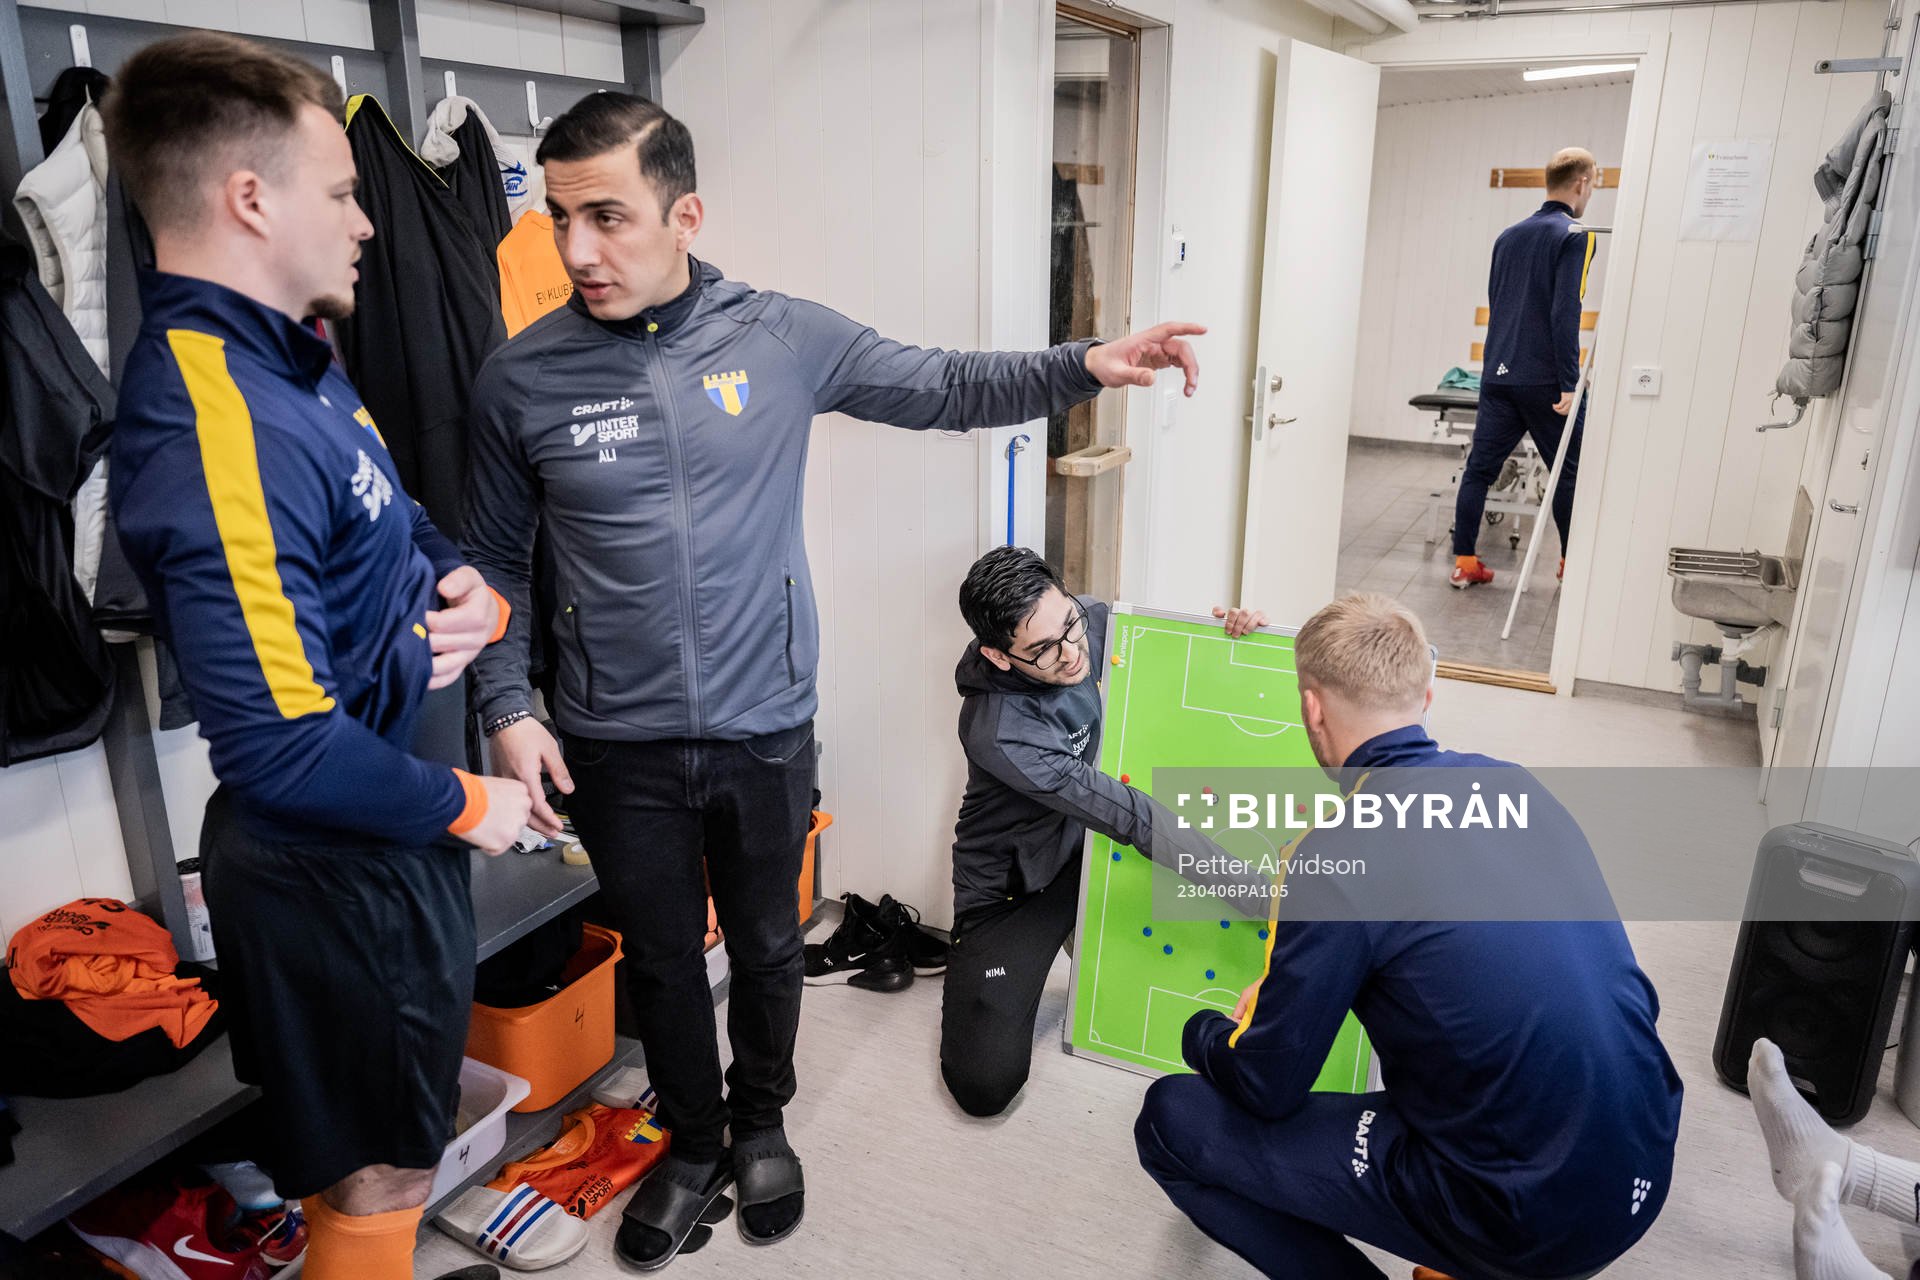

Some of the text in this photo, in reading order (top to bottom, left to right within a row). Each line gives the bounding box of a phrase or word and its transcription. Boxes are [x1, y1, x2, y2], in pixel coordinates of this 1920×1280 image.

[572, 400, 620, 416] CRAFT
[596, 415, 639, 432] INTER
[597, 427, 640, 443] SPORT
[599, 448, 617, 463] ALI
[985, 966, 1006, 979] NIMA
[1355, 1110, 1377, 1160] CRAFT
[459, 1145, 470, 1165] 4
[582, 1176, 611, 1199] INTER
[588, 1180, 615, 1206] SPORT
